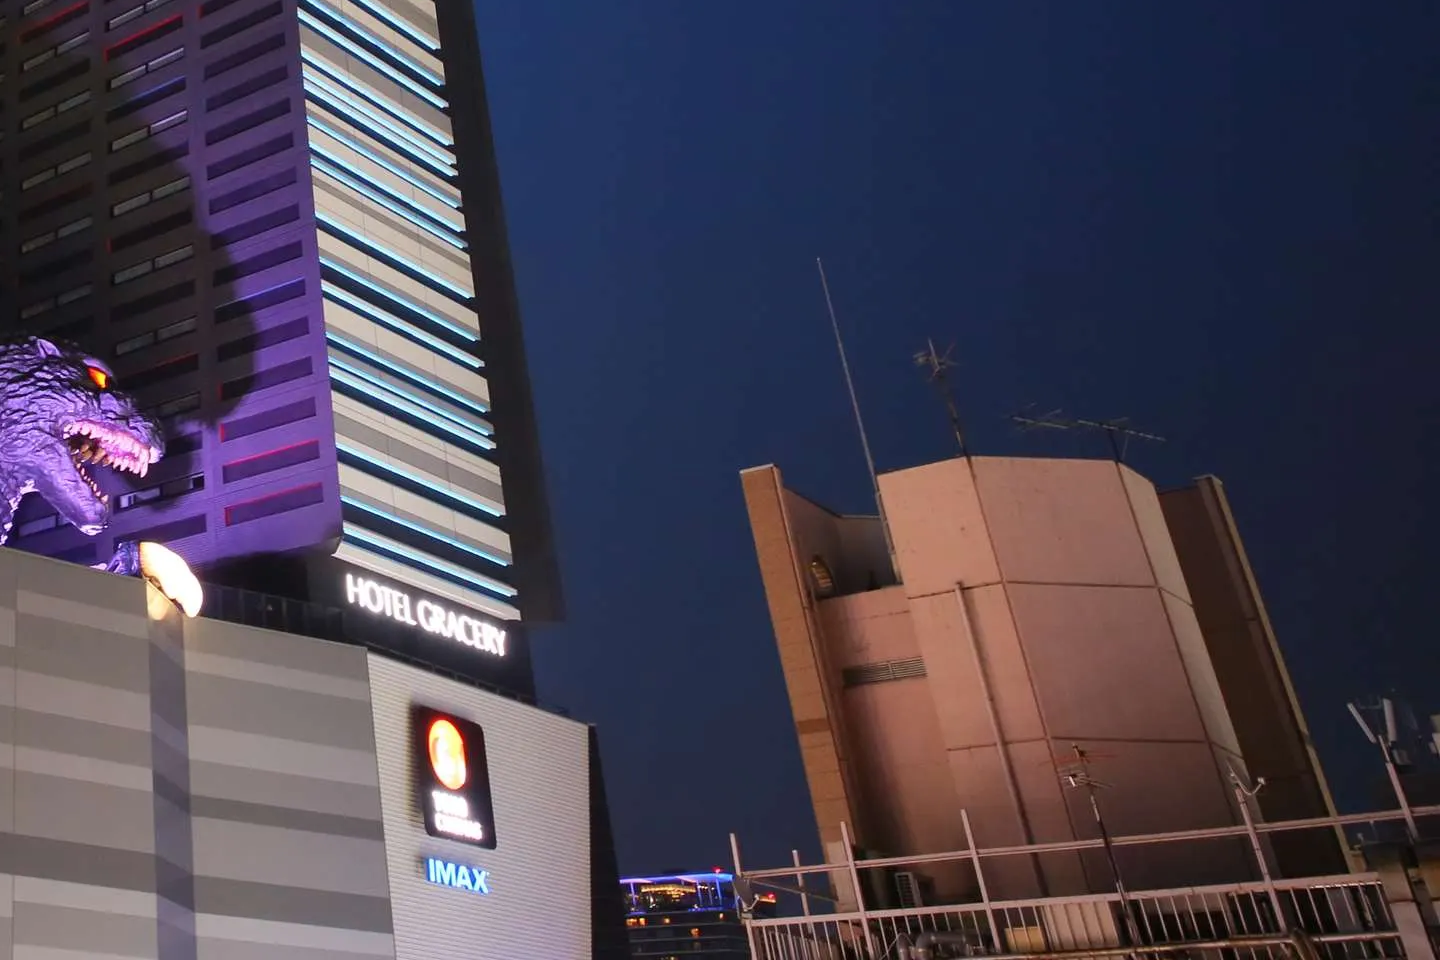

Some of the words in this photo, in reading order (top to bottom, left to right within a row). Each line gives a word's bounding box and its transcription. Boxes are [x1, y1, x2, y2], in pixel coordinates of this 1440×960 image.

[346, 573, 417, 626] HOTEL
[417, 599, 506, 657] GRACERY
[428, 857, 489, 894] IMAX
